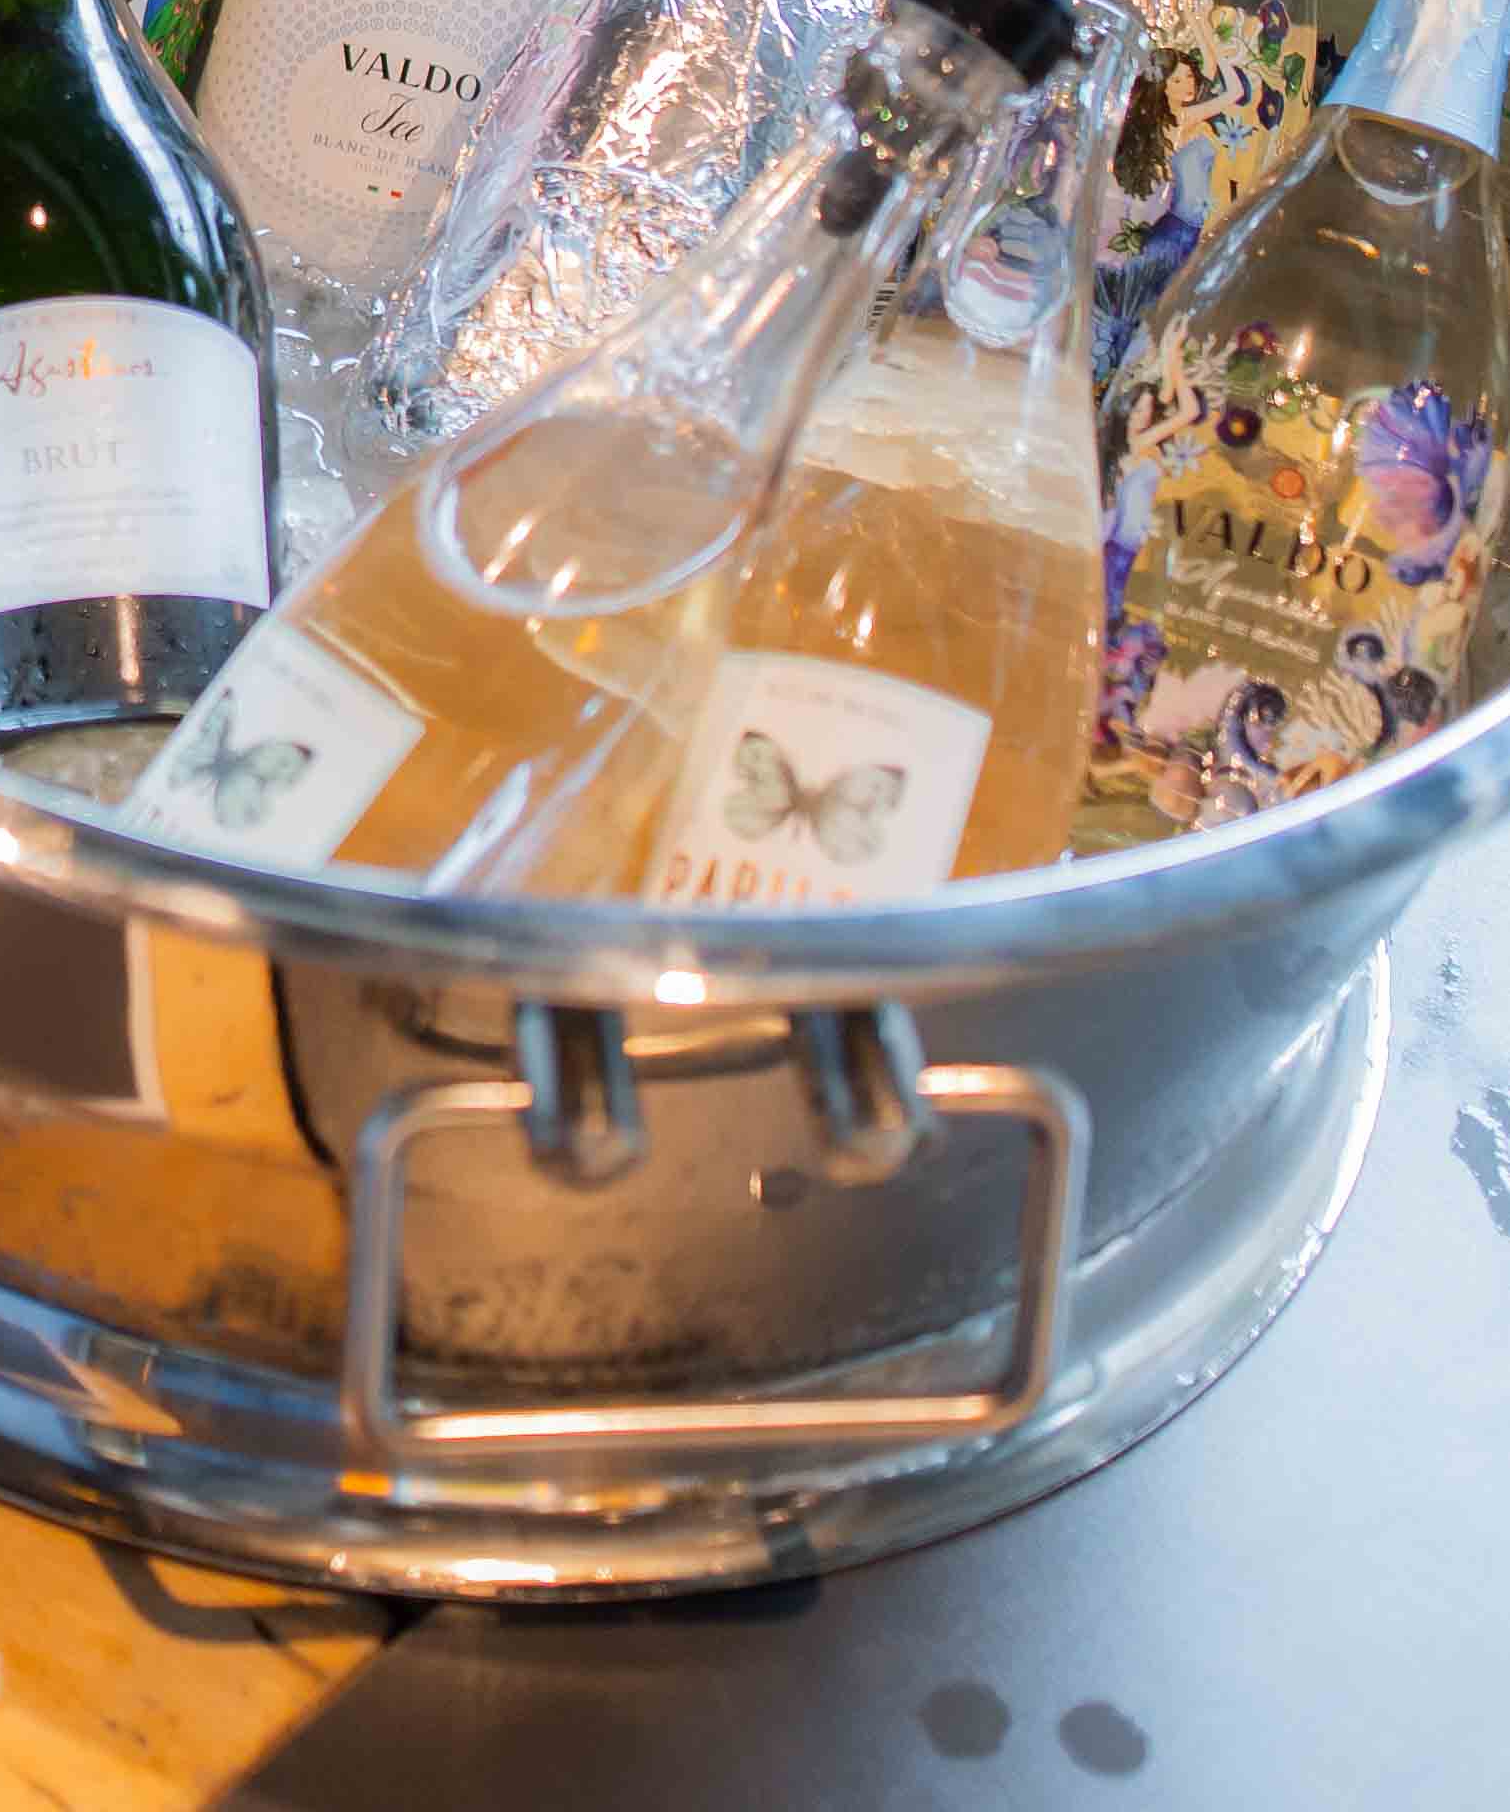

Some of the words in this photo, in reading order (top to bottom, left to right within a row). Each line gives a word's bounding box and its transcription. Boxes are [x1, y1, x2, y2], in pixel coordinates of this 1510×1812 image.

[342, 42, 482, 103] VALDO
[360, 92, 425, 142] Ice
[312, 133, 373, 158] BLANC
[21, 439, 125, 476] BRUT
[1172, 498, 1372, 595] VALDO
